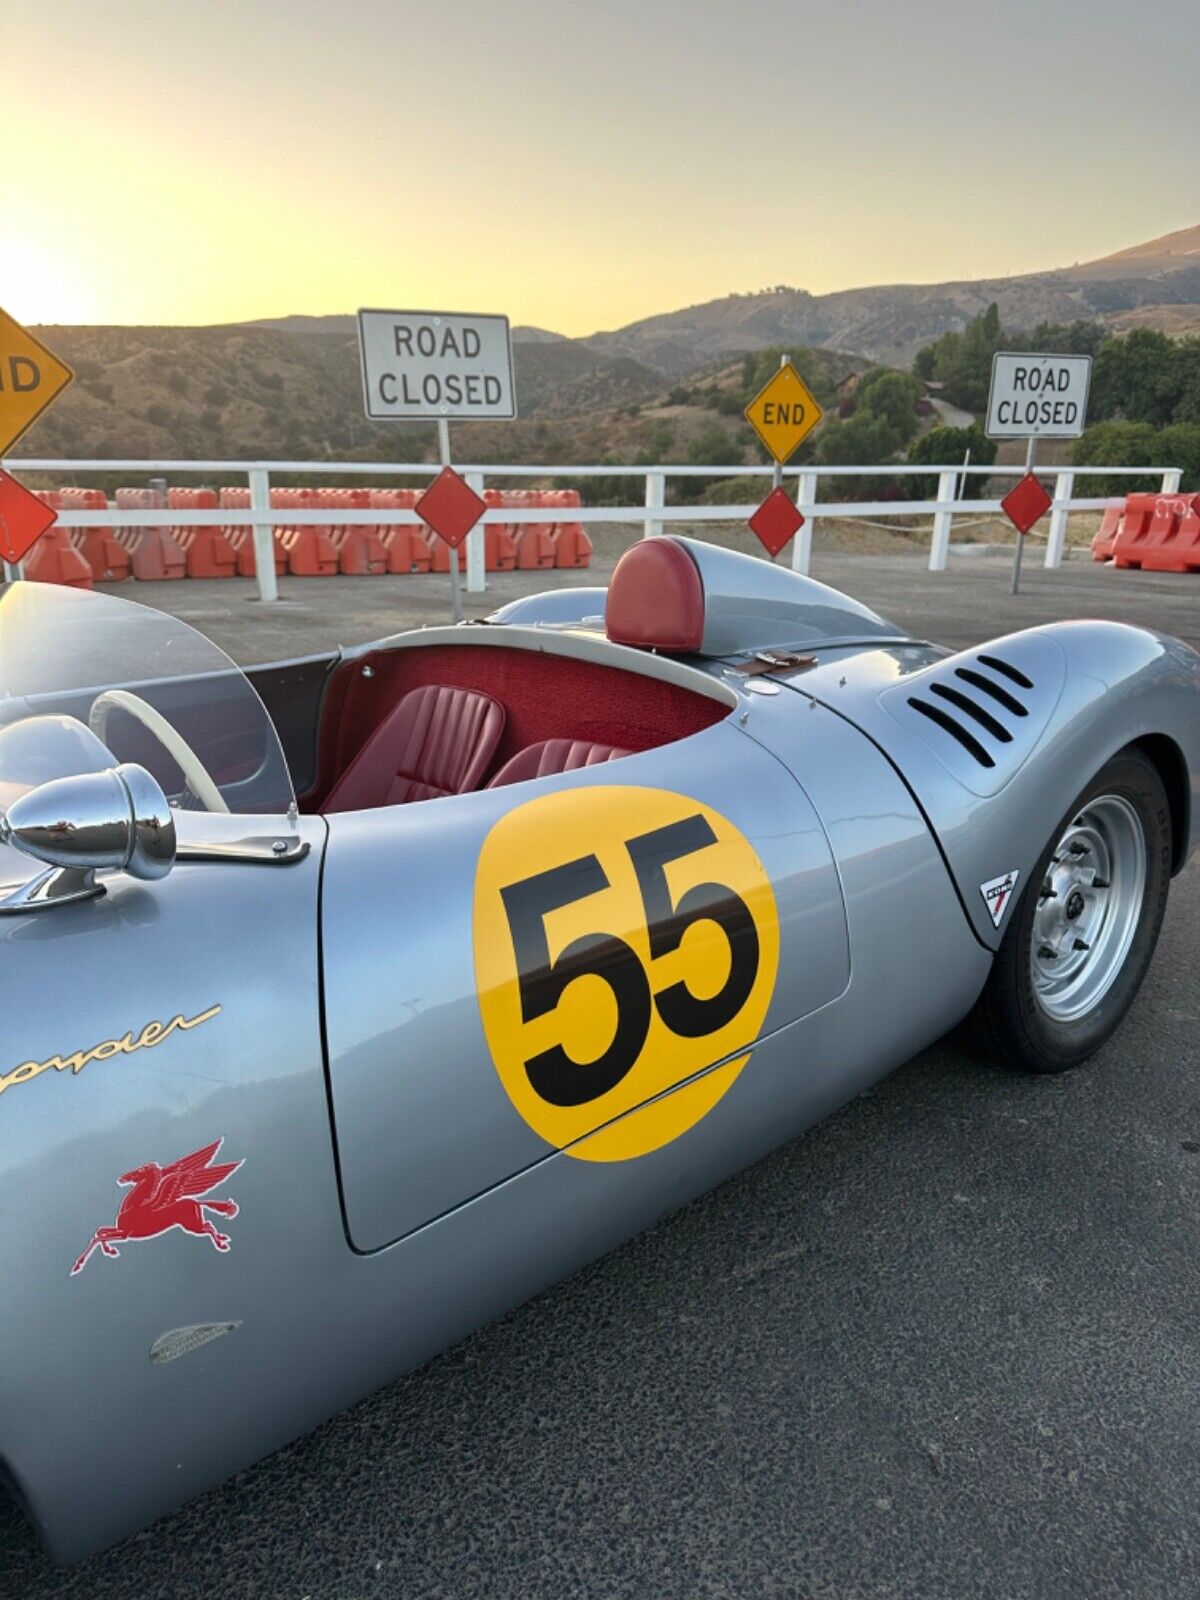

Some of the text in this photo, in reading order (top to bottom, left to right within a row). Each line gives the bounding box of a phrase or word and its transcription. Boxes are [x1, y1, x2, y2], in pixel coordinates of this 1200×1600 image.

[394, 325, 481, 358] ROAD
[379, 372, 502, 405] CLOSED
[1013, 367, 1070, 392] ROAD
[763, 403, 805, 425] END
[997, 400, 1078, 425] CLOSED
[499, 813, 760, 1107] 55
[0, 1003, 223, 1094] pyder
